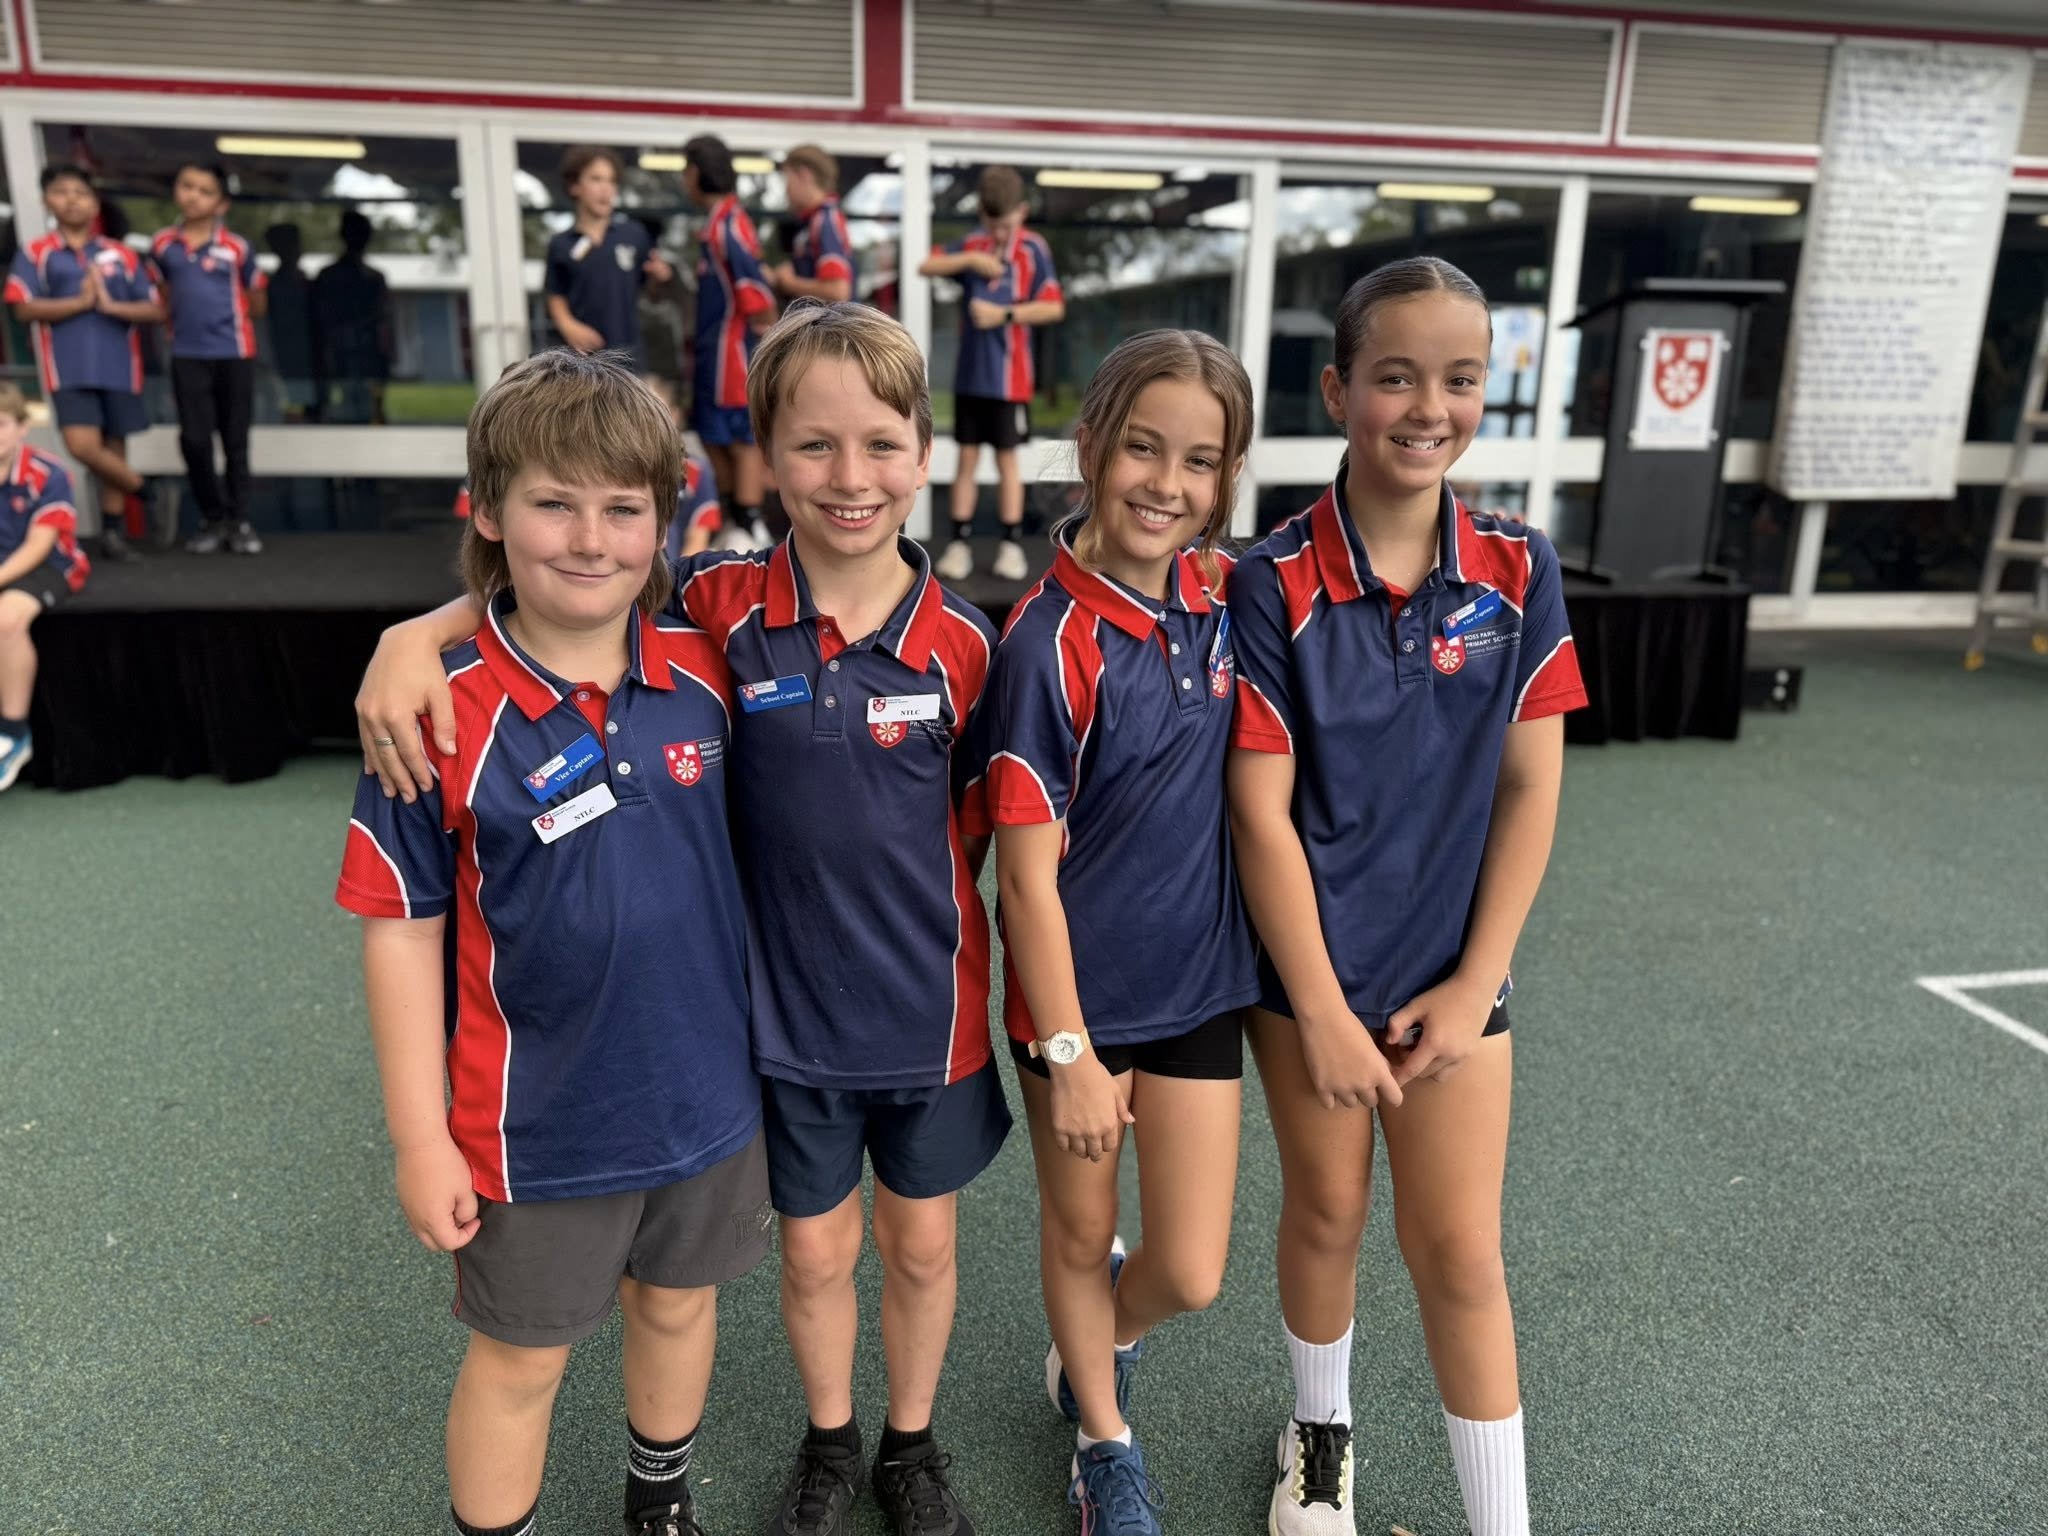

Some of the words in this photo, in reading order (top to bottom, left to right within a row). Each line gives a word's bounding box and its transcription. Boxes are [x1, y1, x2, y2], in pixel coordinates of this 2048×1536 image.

[1463, 618, 1474, 626] Vice
[1474, 605, 1495, 618] Captain
[1464, 632, 1480, 640] ROSS
[1480, 630, 1497, 638] PARK
[1465, 639, 1492, 648] PRIMARY
[1493, 631, 1521, 643] SCHOOL
[760, 695, 780, 704] School
[780, 690, 804, 700] Captain
[555, 770, 570, 782] Vice
[569, 753, 594, 773] Captain
[573, 806, 597, 822] NTLC
